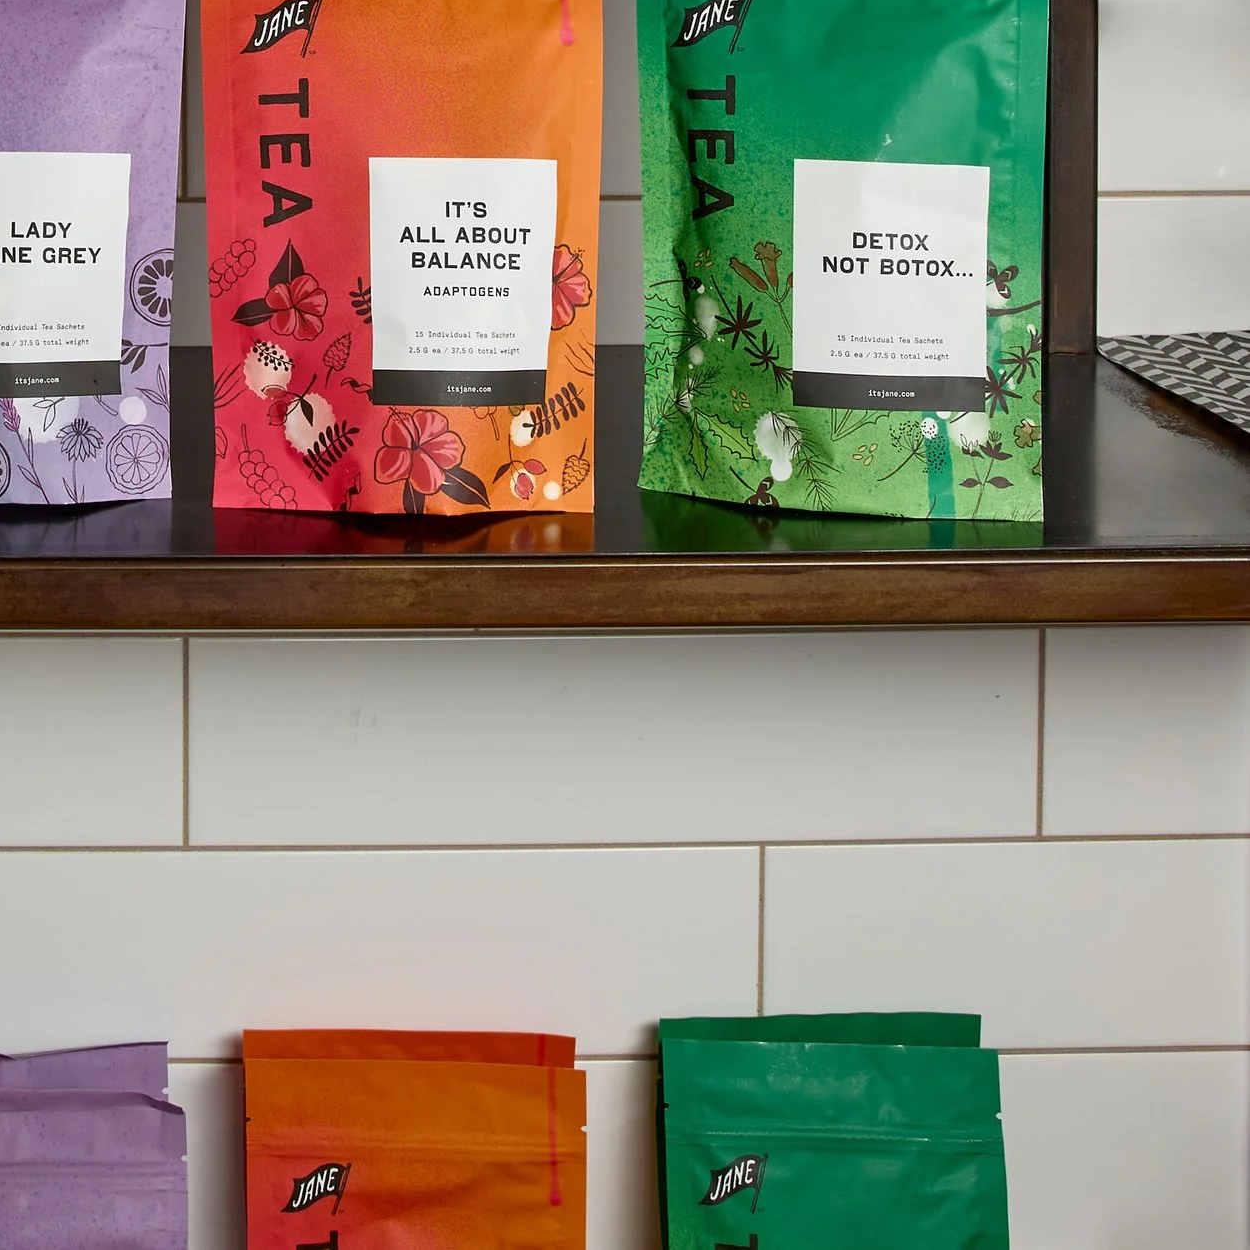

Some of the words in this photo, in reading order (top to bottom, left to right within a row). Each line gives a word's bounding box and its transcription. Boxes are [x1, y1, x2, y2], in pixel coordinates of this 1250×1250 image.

[254, 0, 308, 47] JANE
[258, 78, 312, 228] TEA
[686, 75, 736, 221] TEA
[446, 202, 487, 218] IT'S
[11, 222, 71, 238] LADY
[400, 227, 445, 243] ALL
[455, 227, 530, 244] ABOUT
[853, 232, 928, 251] DETOX
[43, 247, 101, 264] GREY
[412, 252, 520, 270] BALANCE
[823, 256, 869, 274] NOT
[880, 259, 972, 277] BOTOX...
[424, 286, 509, 297] ADAPTOGENS
[15, 377, 59, 385] itsjane.com
[447, 386, 491, 394] itsjane.com
[869, 390, 914, 398] itsjane.com
[292, 1168, 338, 1208] JANE
[710, 1160, 756, 1200] JANE
